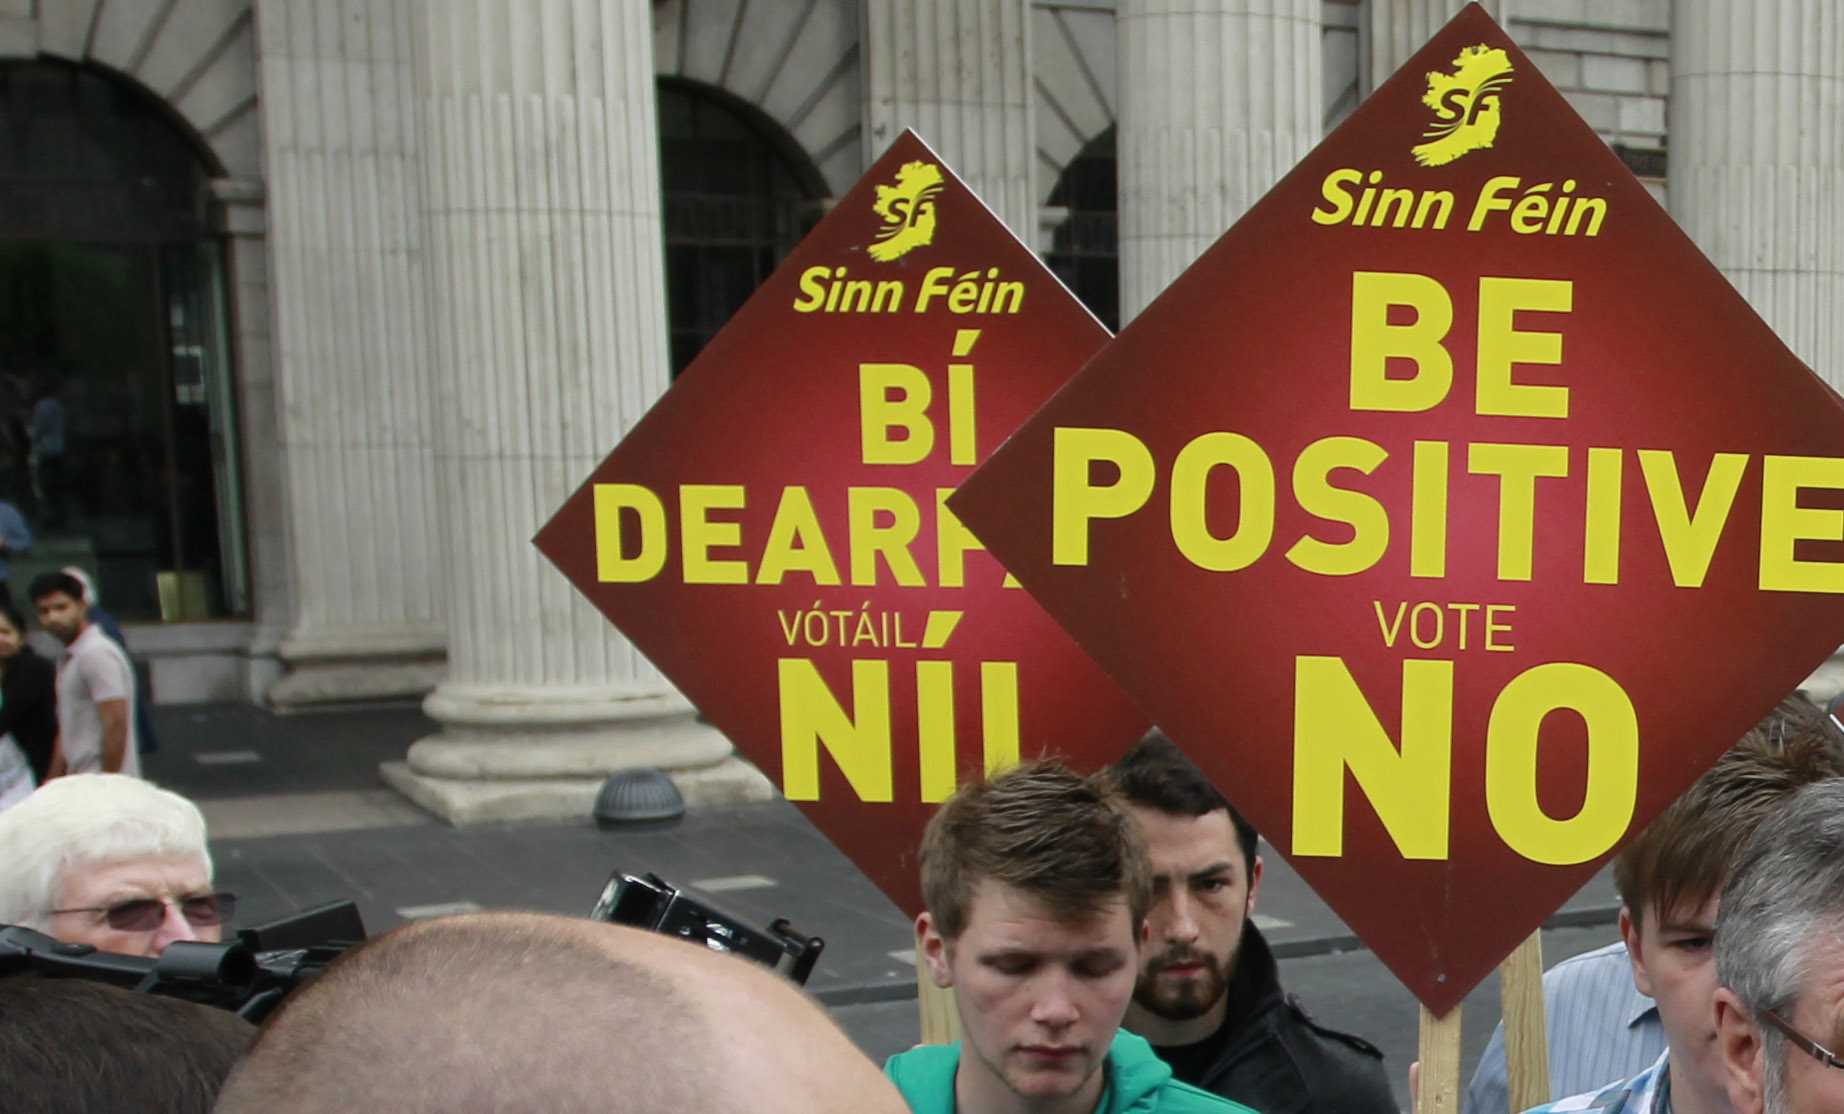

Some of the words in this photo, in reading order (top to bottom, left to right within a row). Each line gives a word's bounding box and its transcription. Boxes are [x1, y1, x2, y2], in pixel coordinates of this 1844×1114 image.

[1311, 168, 1459, 233] Sinn
[1469, 176, 1607, 238] Féin
[793, 265, 903, 314] Sinn
[915, 267, 1024, 314] Féin
[1348, 271, 1574, 418] BE
[858, 329, 977, 466] BÍ
[778, 601, 918, 648] VÓTÁIL
[1373, 601, 1516, 652] VOTE
[1291, 655, 1640, 865] NO
